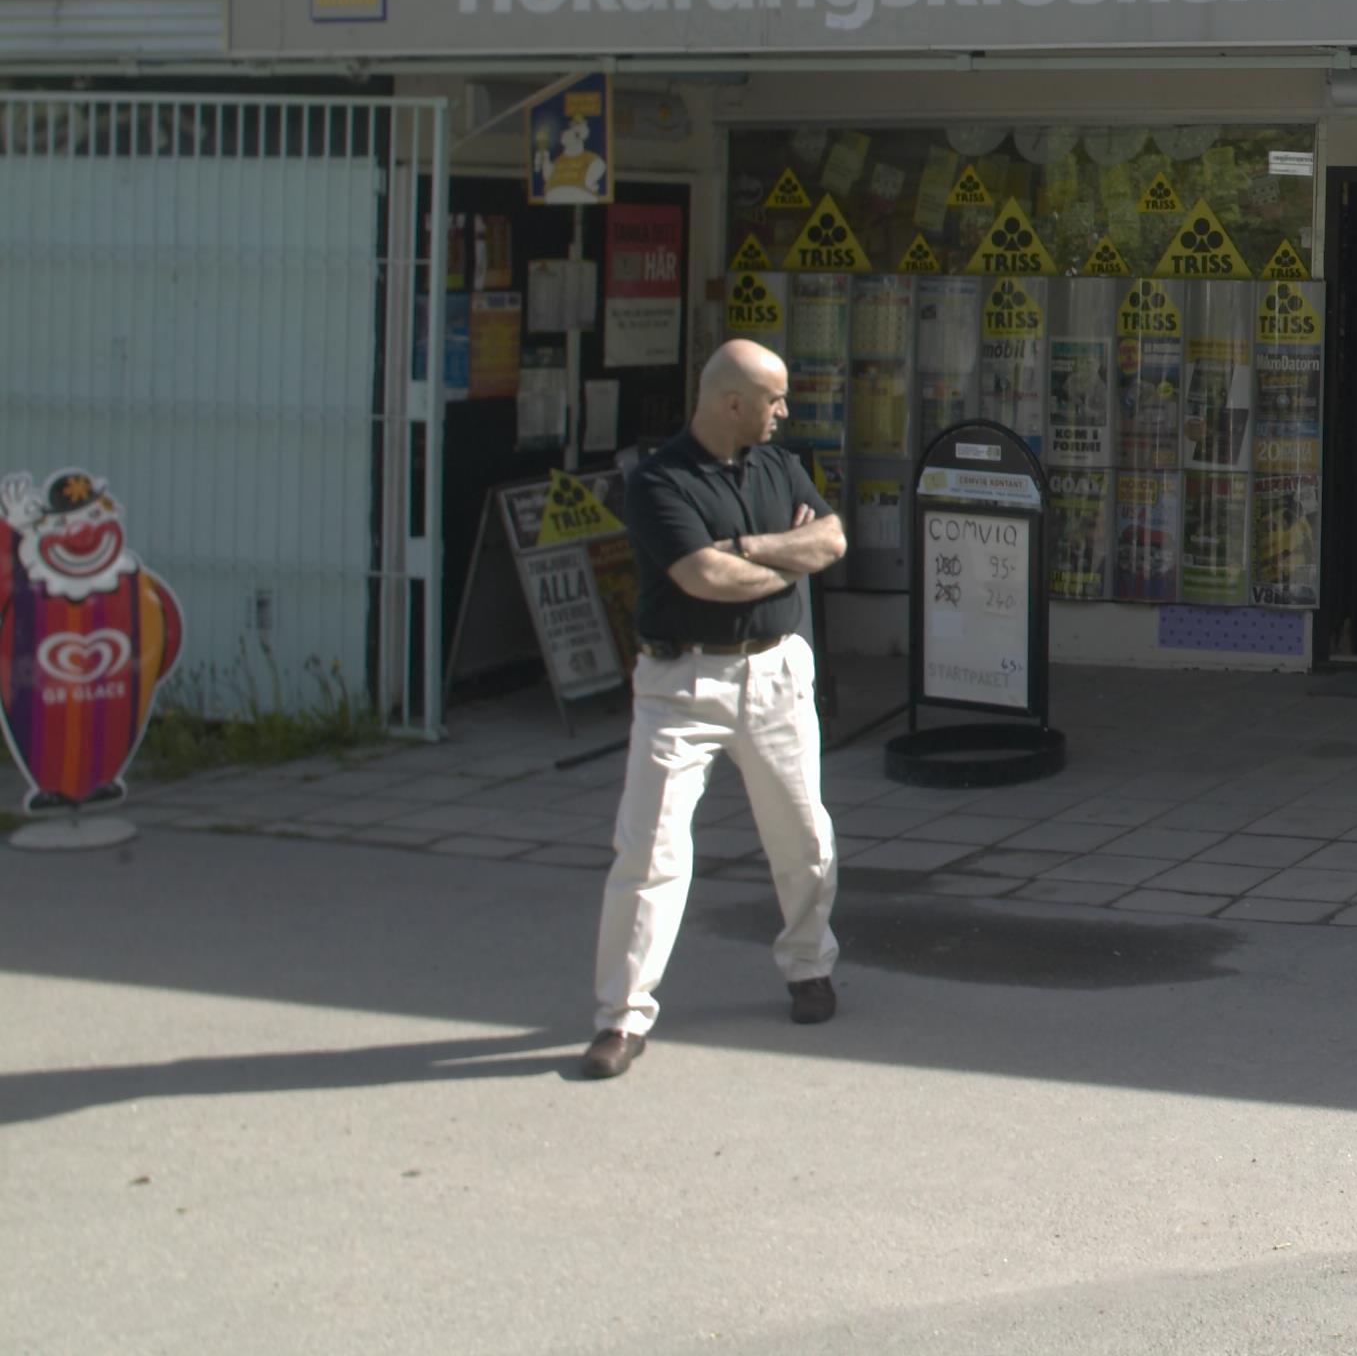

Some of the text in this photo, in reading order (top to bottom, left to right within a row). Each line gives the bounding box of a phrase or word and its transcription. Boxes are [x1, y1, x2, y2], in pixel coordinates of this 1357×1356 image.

[774, 195, 803, 205] TRISS
[955, 193, 985, 203] TRISS
[1145, 199, 1176, 211] TRISS
[644, 247, 677, 282] HÄR
[799, 248, 856, 268] TRISS
[905, 260, 935, 272] TRISS
[983, 253, 1042, 273] TRISS
[1172, 254, 1233, 274] TRISS
[1091, 262, 1121, 273] TRISS
[1270, 268, 1302, 278] TRISS
[729, 305, 778, 323] TRISS
[986, 311, 1039, 329] TRISS
[1122, 312, 1177, 331] TRISS
[1259, 315, 1314, 334] TRISS
[990, 478, 1023, 488] KONTANT
[551, 505, 601, 532] TRISS
[929, 518, 1017, 548] COMVIQ
[539, 570, 590, 609] ALLA
